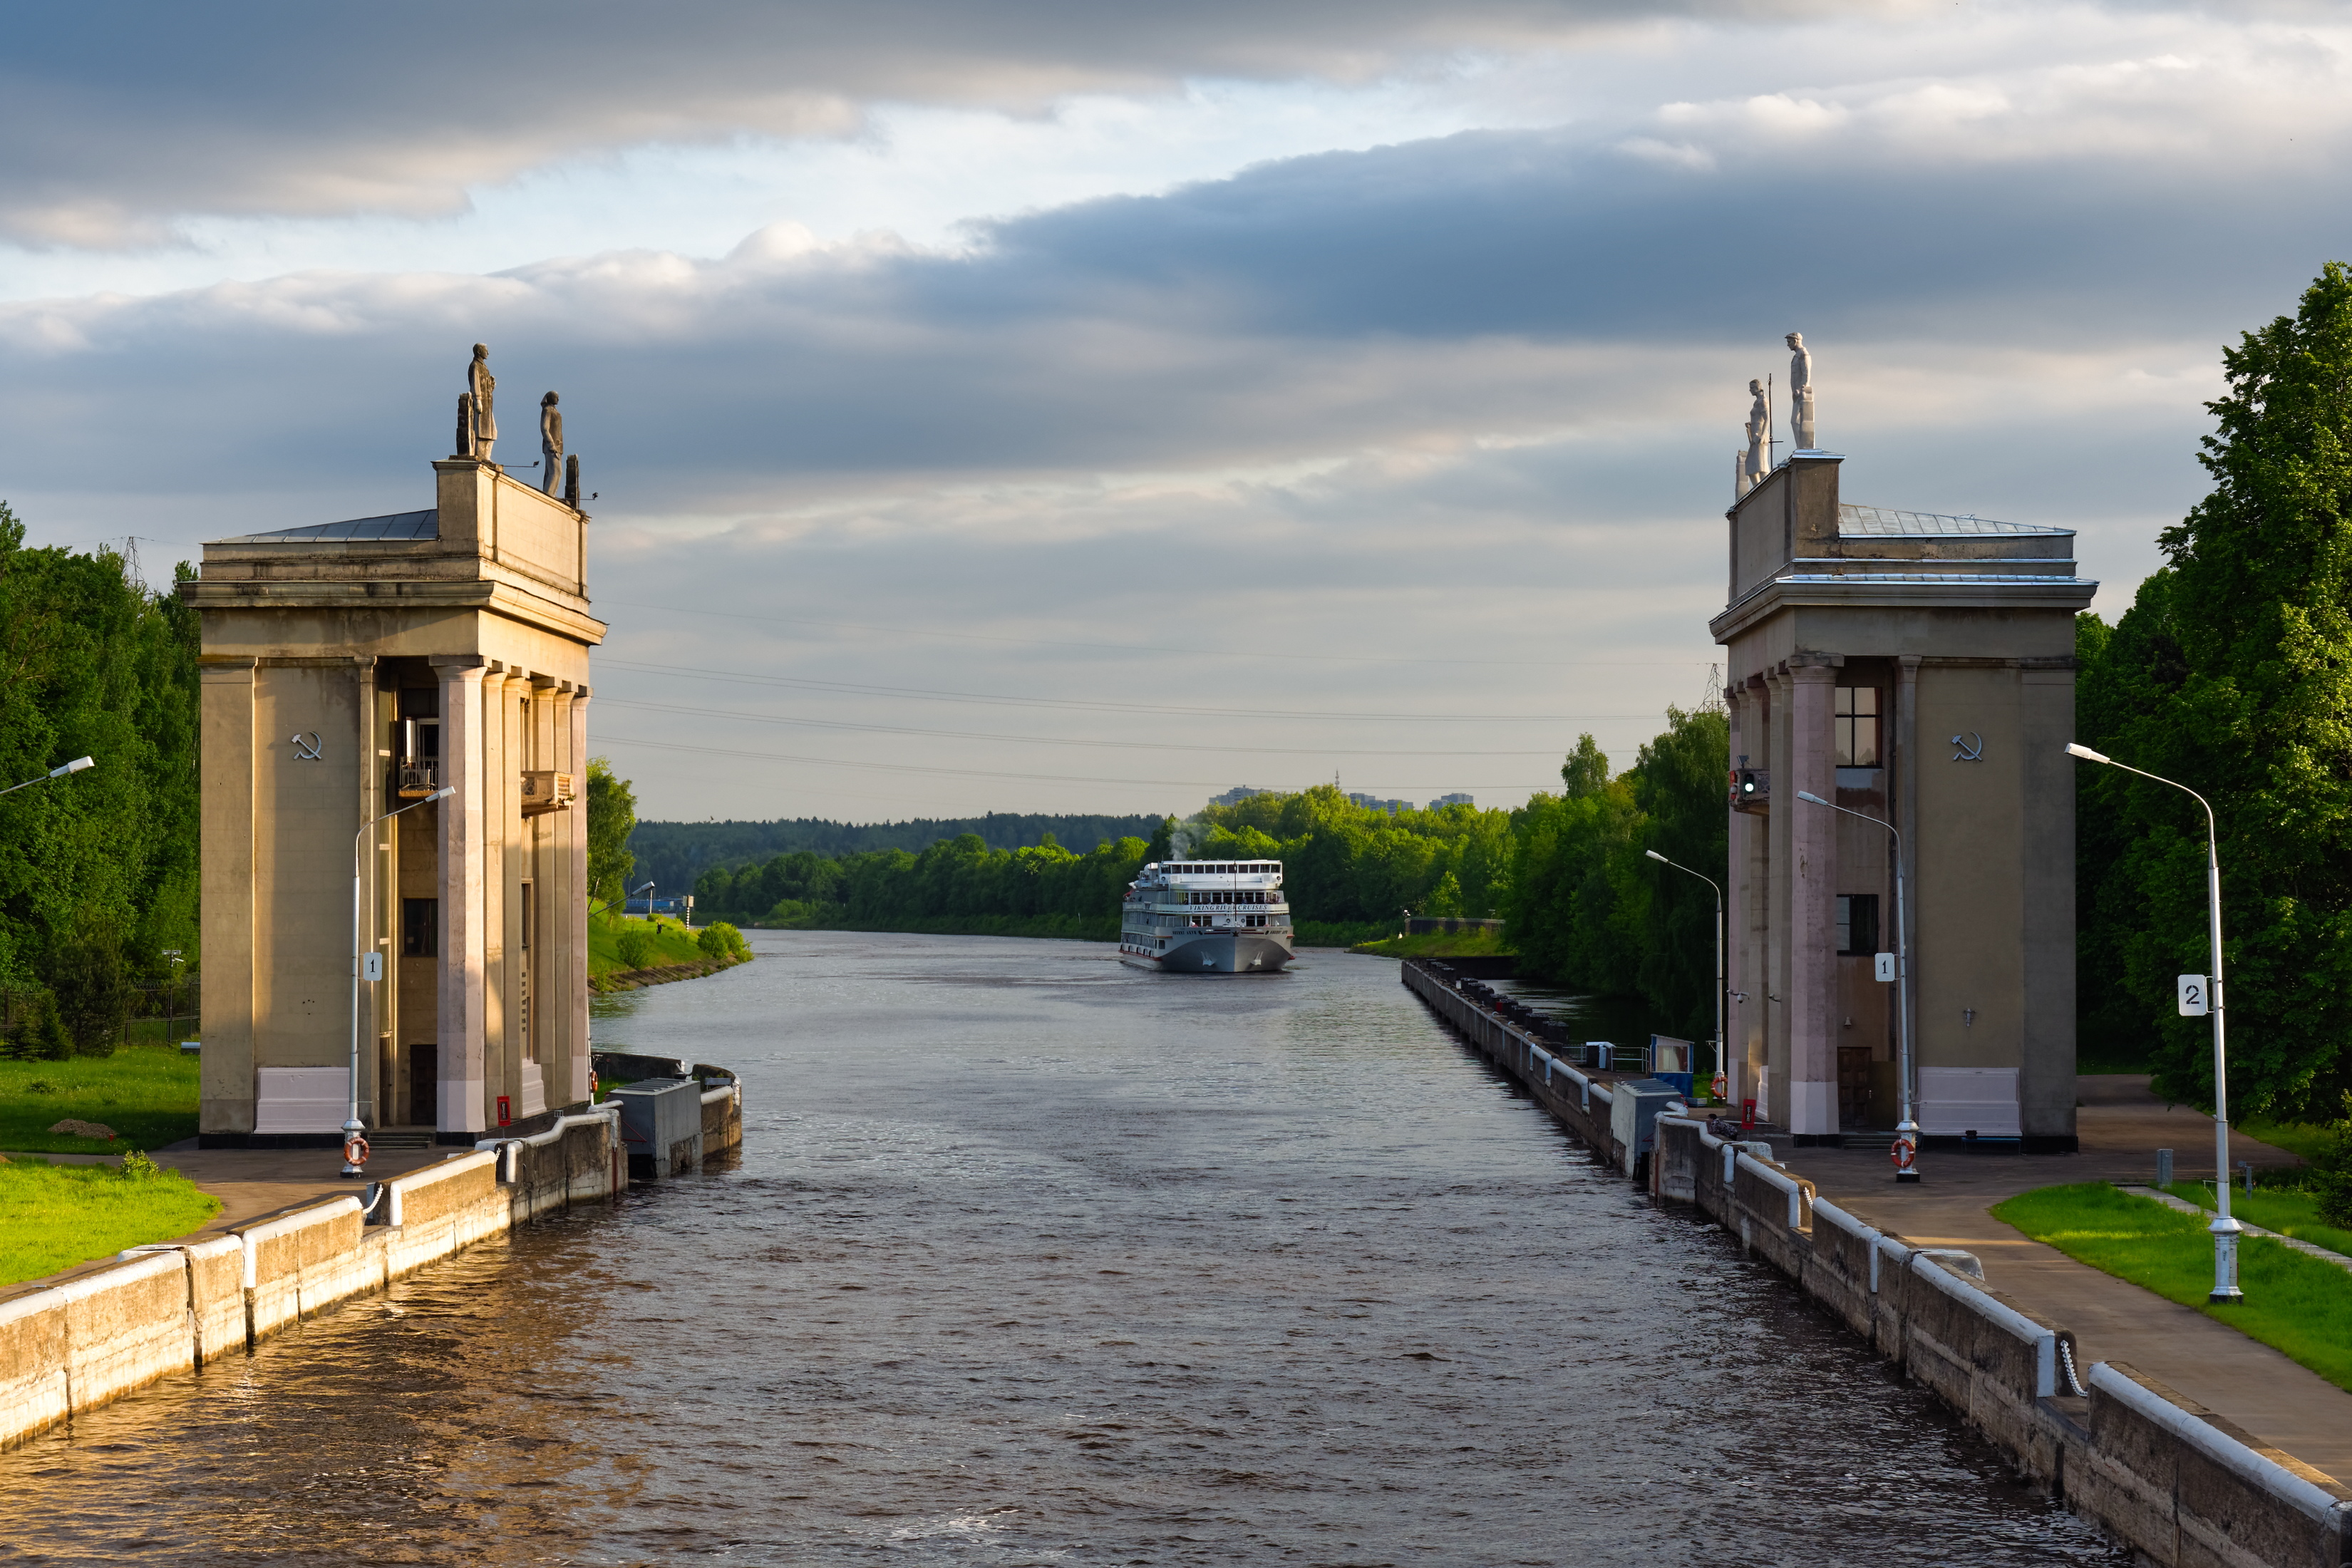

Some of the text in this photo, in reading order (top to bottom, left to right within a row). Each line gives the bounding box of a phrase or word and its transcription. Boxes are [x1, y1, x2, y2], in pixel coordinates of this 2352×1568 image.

[371, 959, 376, 972] 1
[1882, 960, 1887, 974] 1
[2185, 984, 2199, 1004] 2
